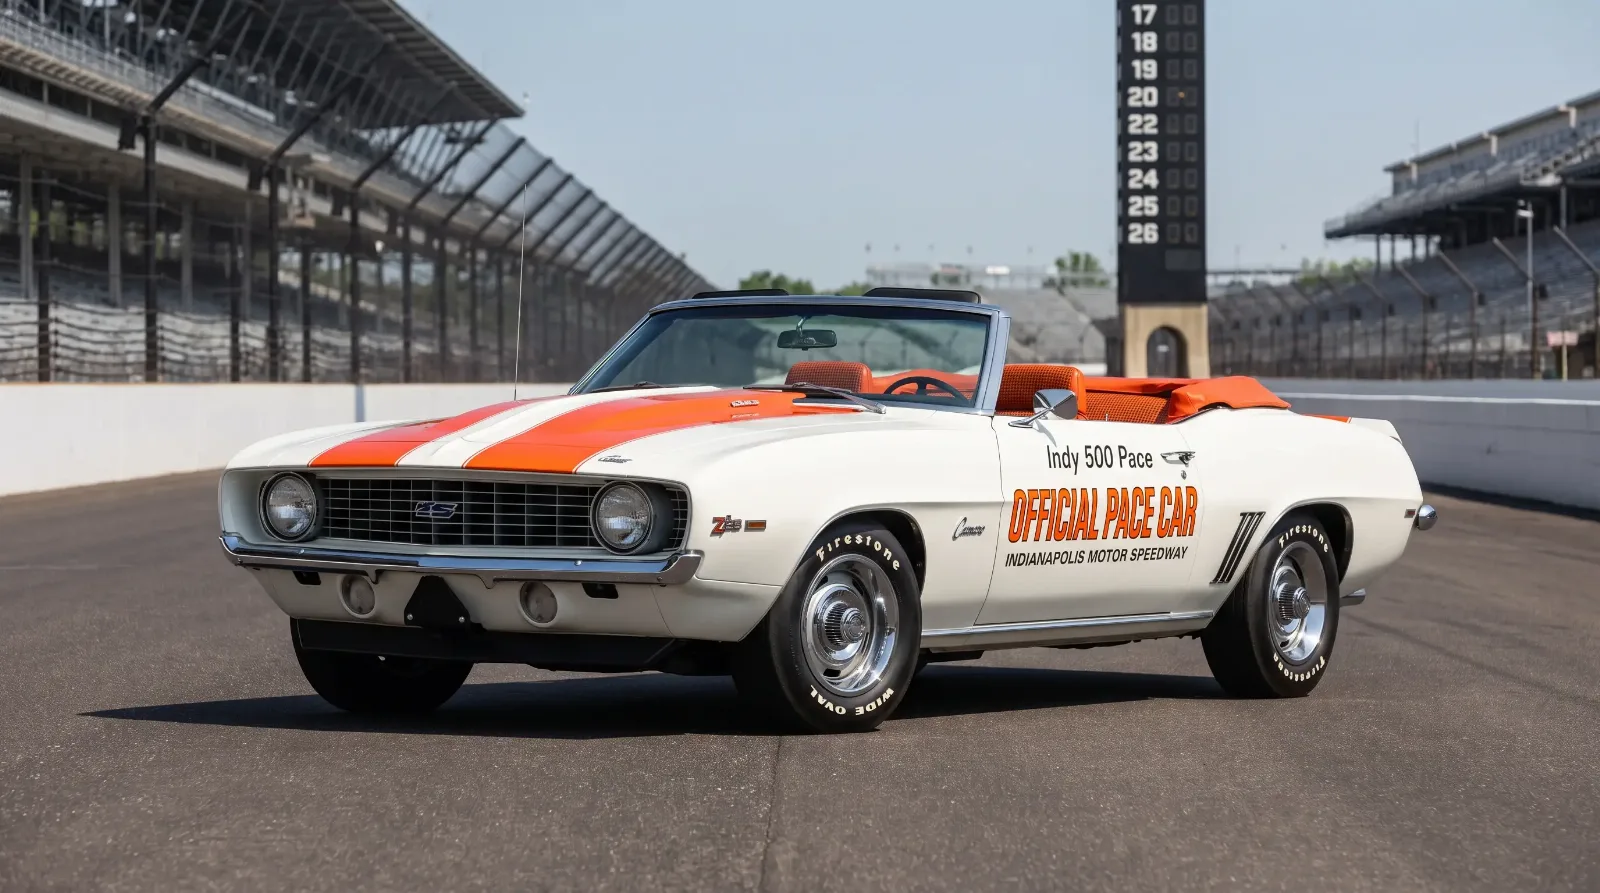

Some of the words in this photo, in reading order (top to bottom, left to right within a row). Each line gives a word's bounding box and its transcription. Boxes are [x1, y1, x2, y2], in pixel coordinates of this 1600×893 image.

[1131, 4, 1157, 25] 17
[1131, 31, 1157, 52] 18
[1131, 59, 1157, 80] 19
[1128, 86, 1158, 107] 20
[1128, 114, 1158, 135] 22
[1128, 141, 1158, 162] 23
[1128, 168, 1159, 189] 24
[1128, 196, 1158, 217] 25
[1128, 223, 1158, 244] 26
[1047, 445, 1079, 475] Indy
[1084, 445, 1113, 468] 500
[1118, 445, 1153, 468] Pace
[1008, 488, 1099, 543] OFFICIAL
[1102, 486, 1155, 539] PACE
[1157, 486, 1198, 538] CAR
[1278, 525, 1329, 553] Firestone
[815, 533, 900, 571] Firestone
[1005, 550, 1085, 567] INDIANAPOLIS
[1087, 548, 1128, 563] MOTOR
[1129, 546, 1188, 561] SPEEDWAY
[809, 684, 846, 715] OVAL
[855, 687, 894, 716] WIDE
